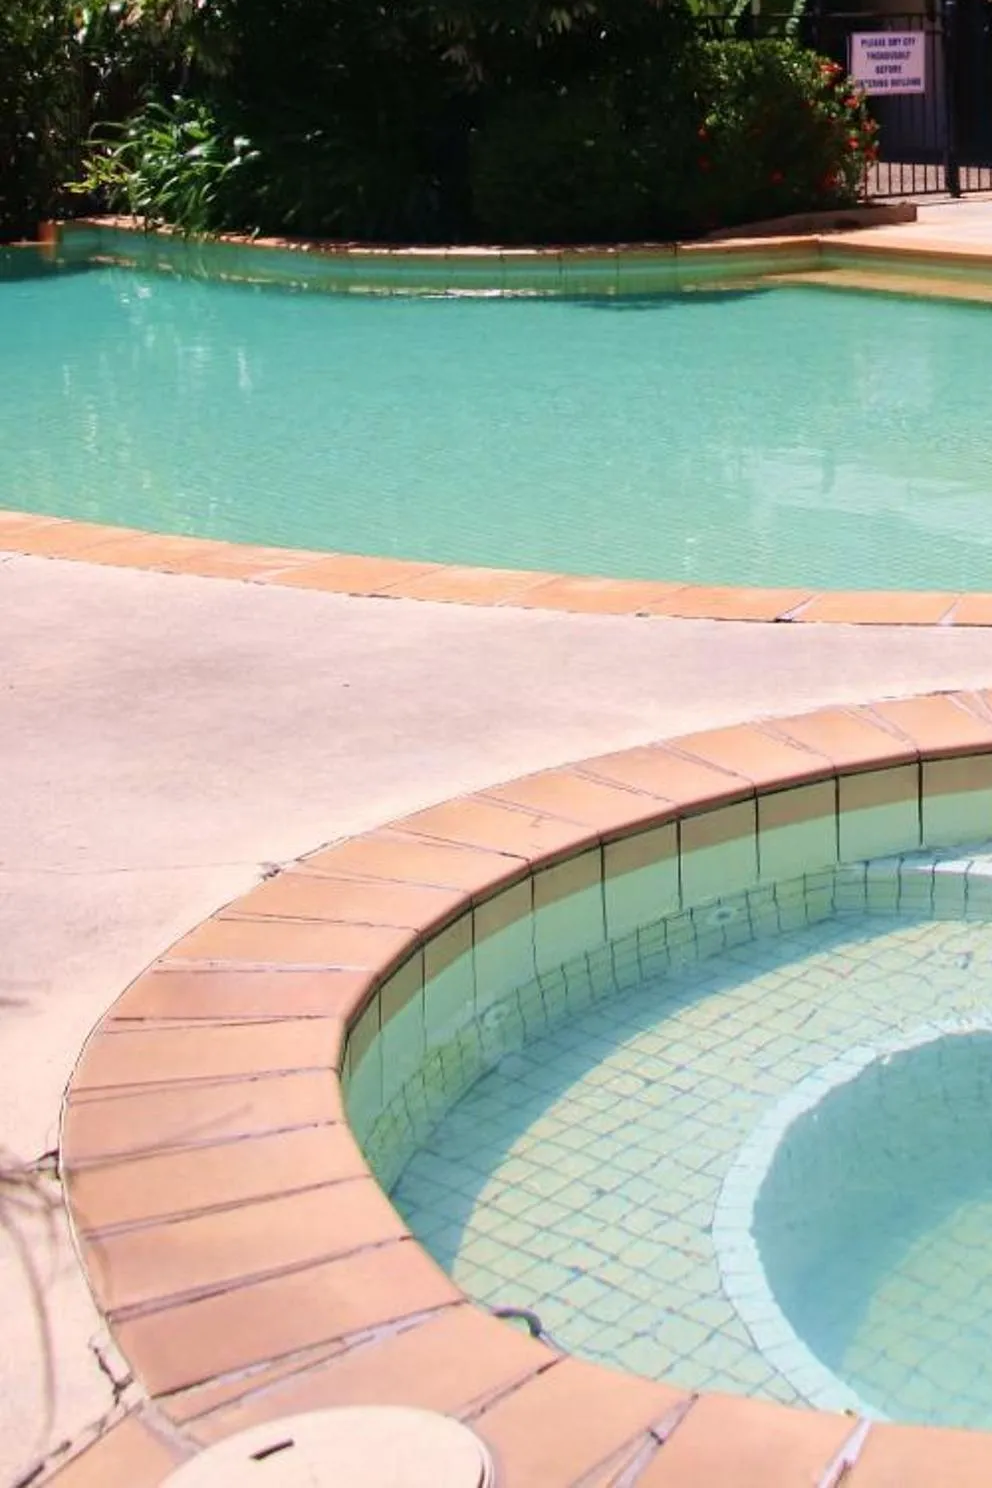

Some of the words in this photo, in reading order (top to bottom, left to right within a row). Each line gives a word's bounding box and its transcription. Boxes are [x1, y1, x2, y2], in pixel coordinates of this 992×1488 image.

[861, 38, 886, 48] PLEASE
[888, 37, 902, 47] DRY
[903, 36, 916, 46] OFF
[875, 65, 902, 74] BEFORE
